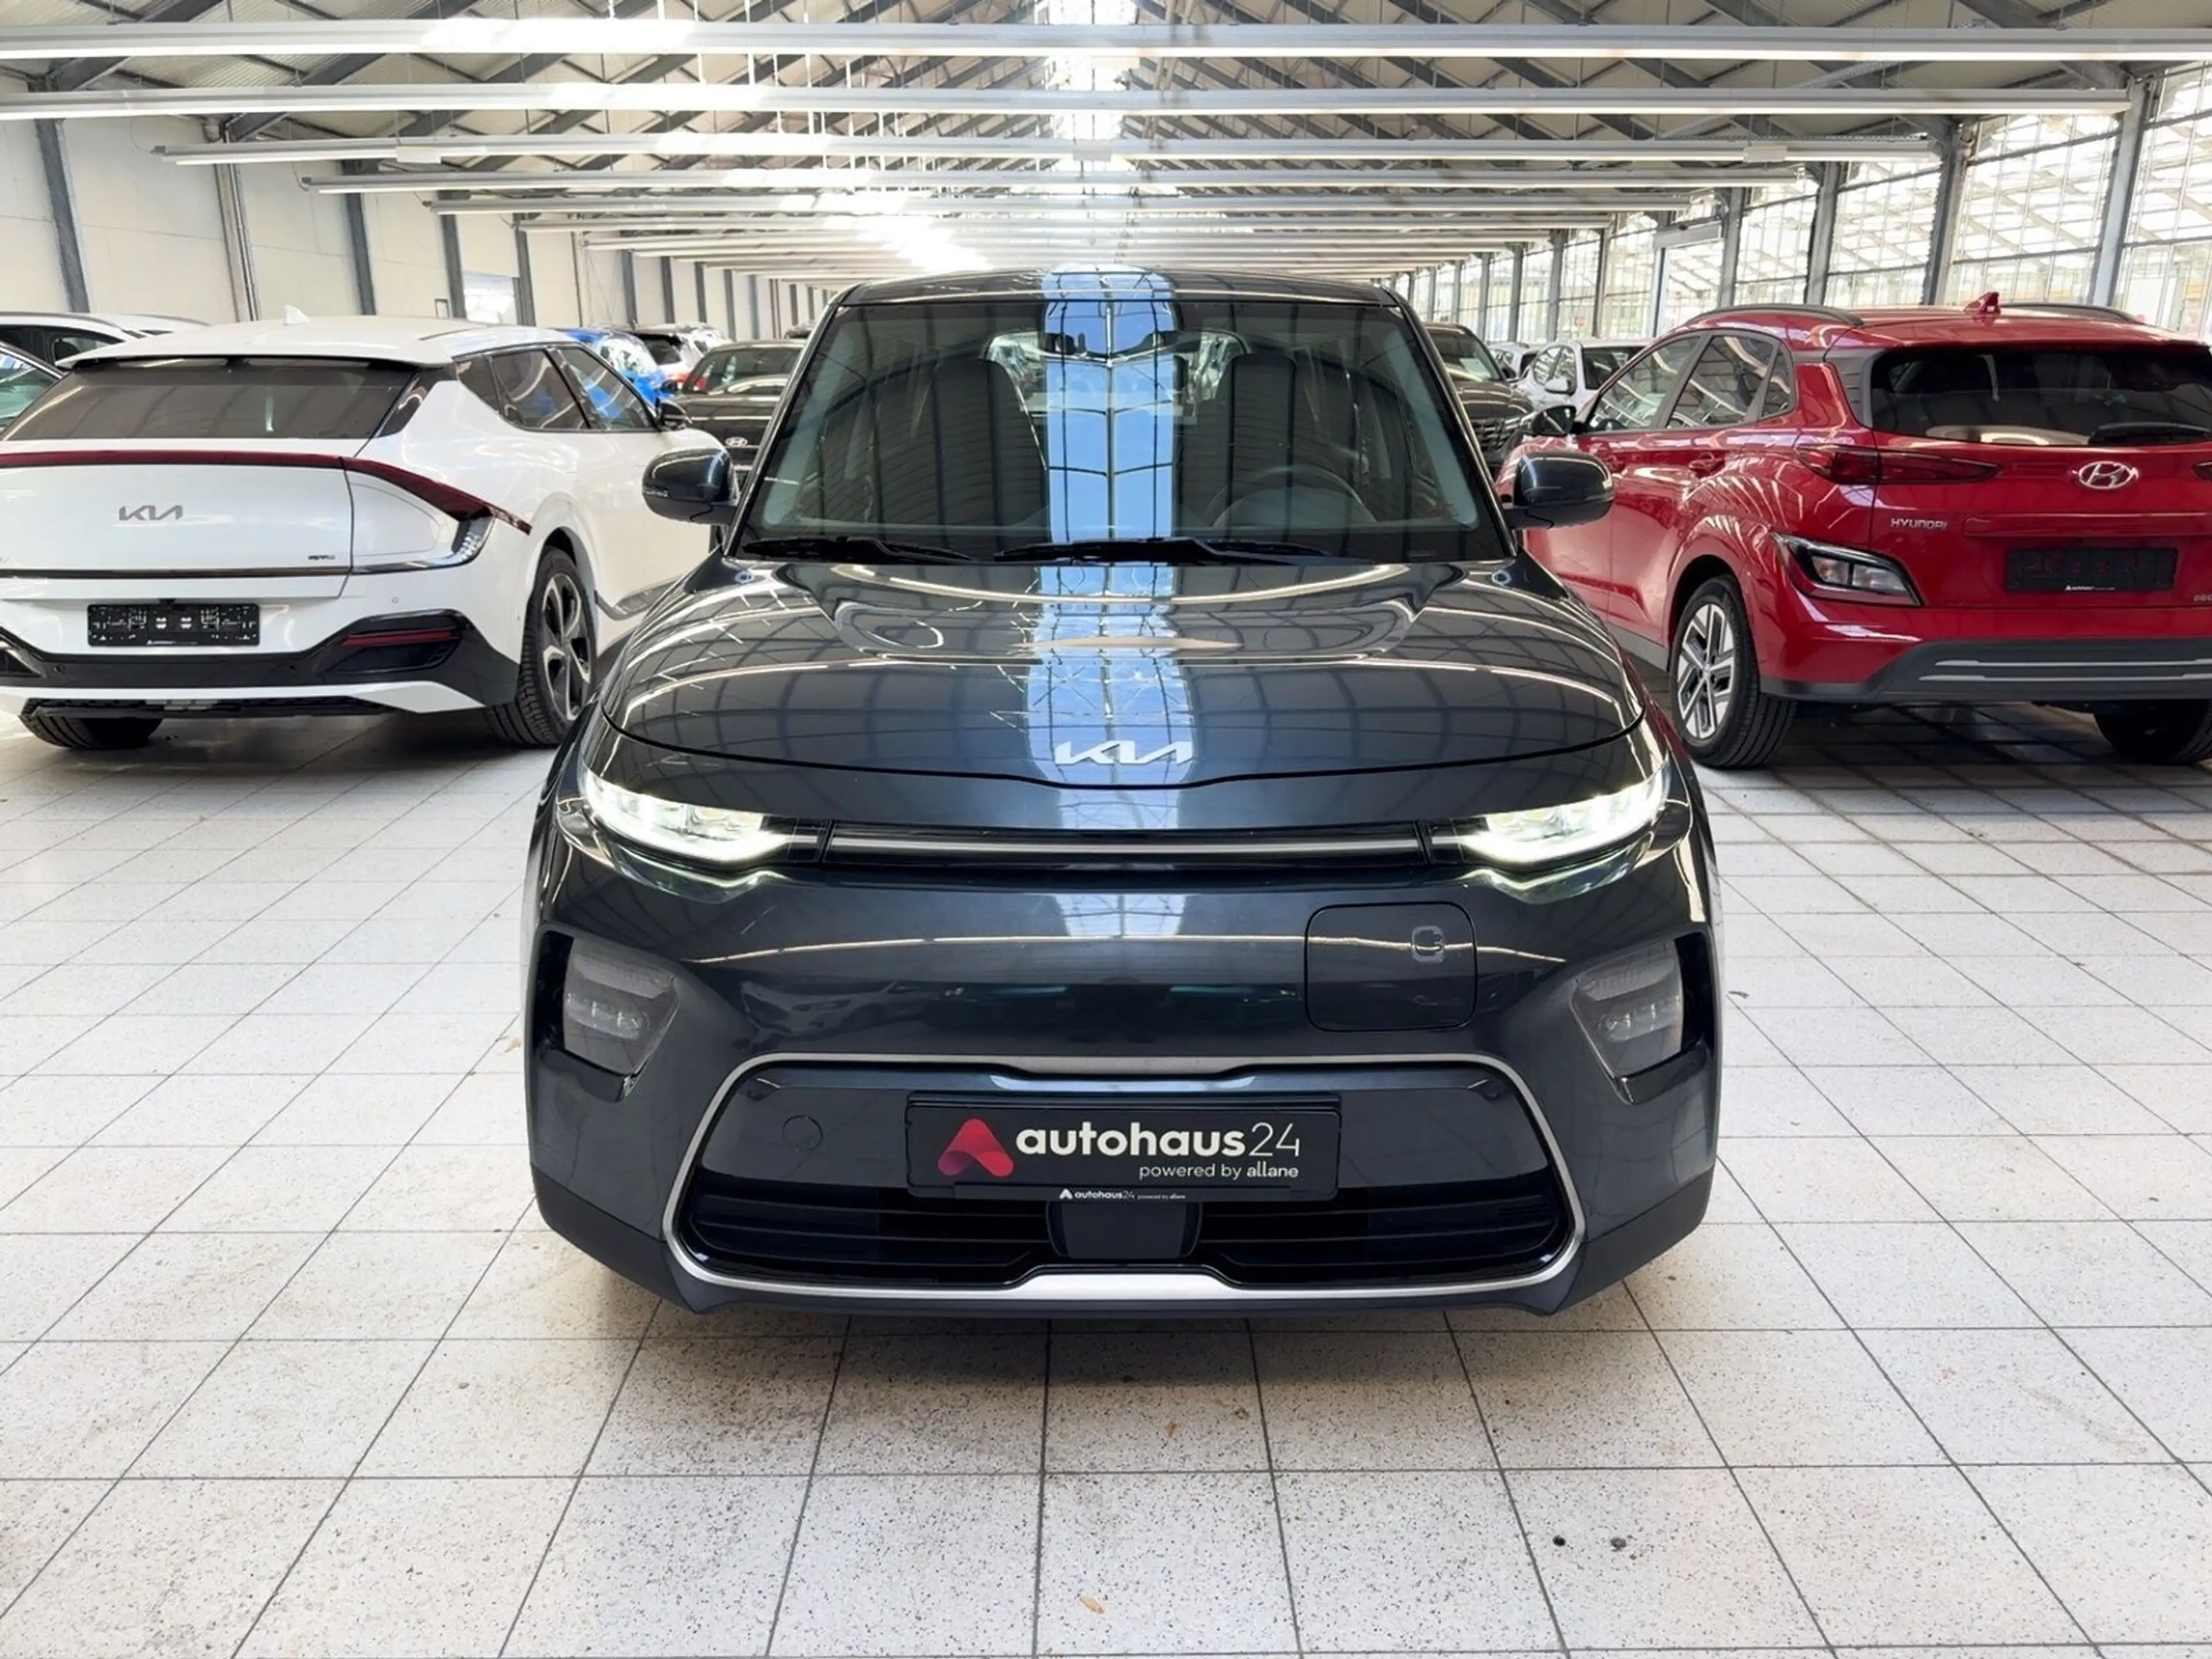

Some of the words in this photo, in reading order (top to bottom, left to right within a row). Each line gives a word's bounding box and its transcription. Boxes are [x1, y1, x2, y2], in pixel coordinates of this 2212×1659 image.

[1891, 518, 1947, 529] HYUNDAI
[1016, 1121, 1300, 1157] autohaus24
[1139, 1161, 1216, 1180] powered
[1221, 1161, 1242, 1180] by
[1247, 1161, 1300, 1178] allane
